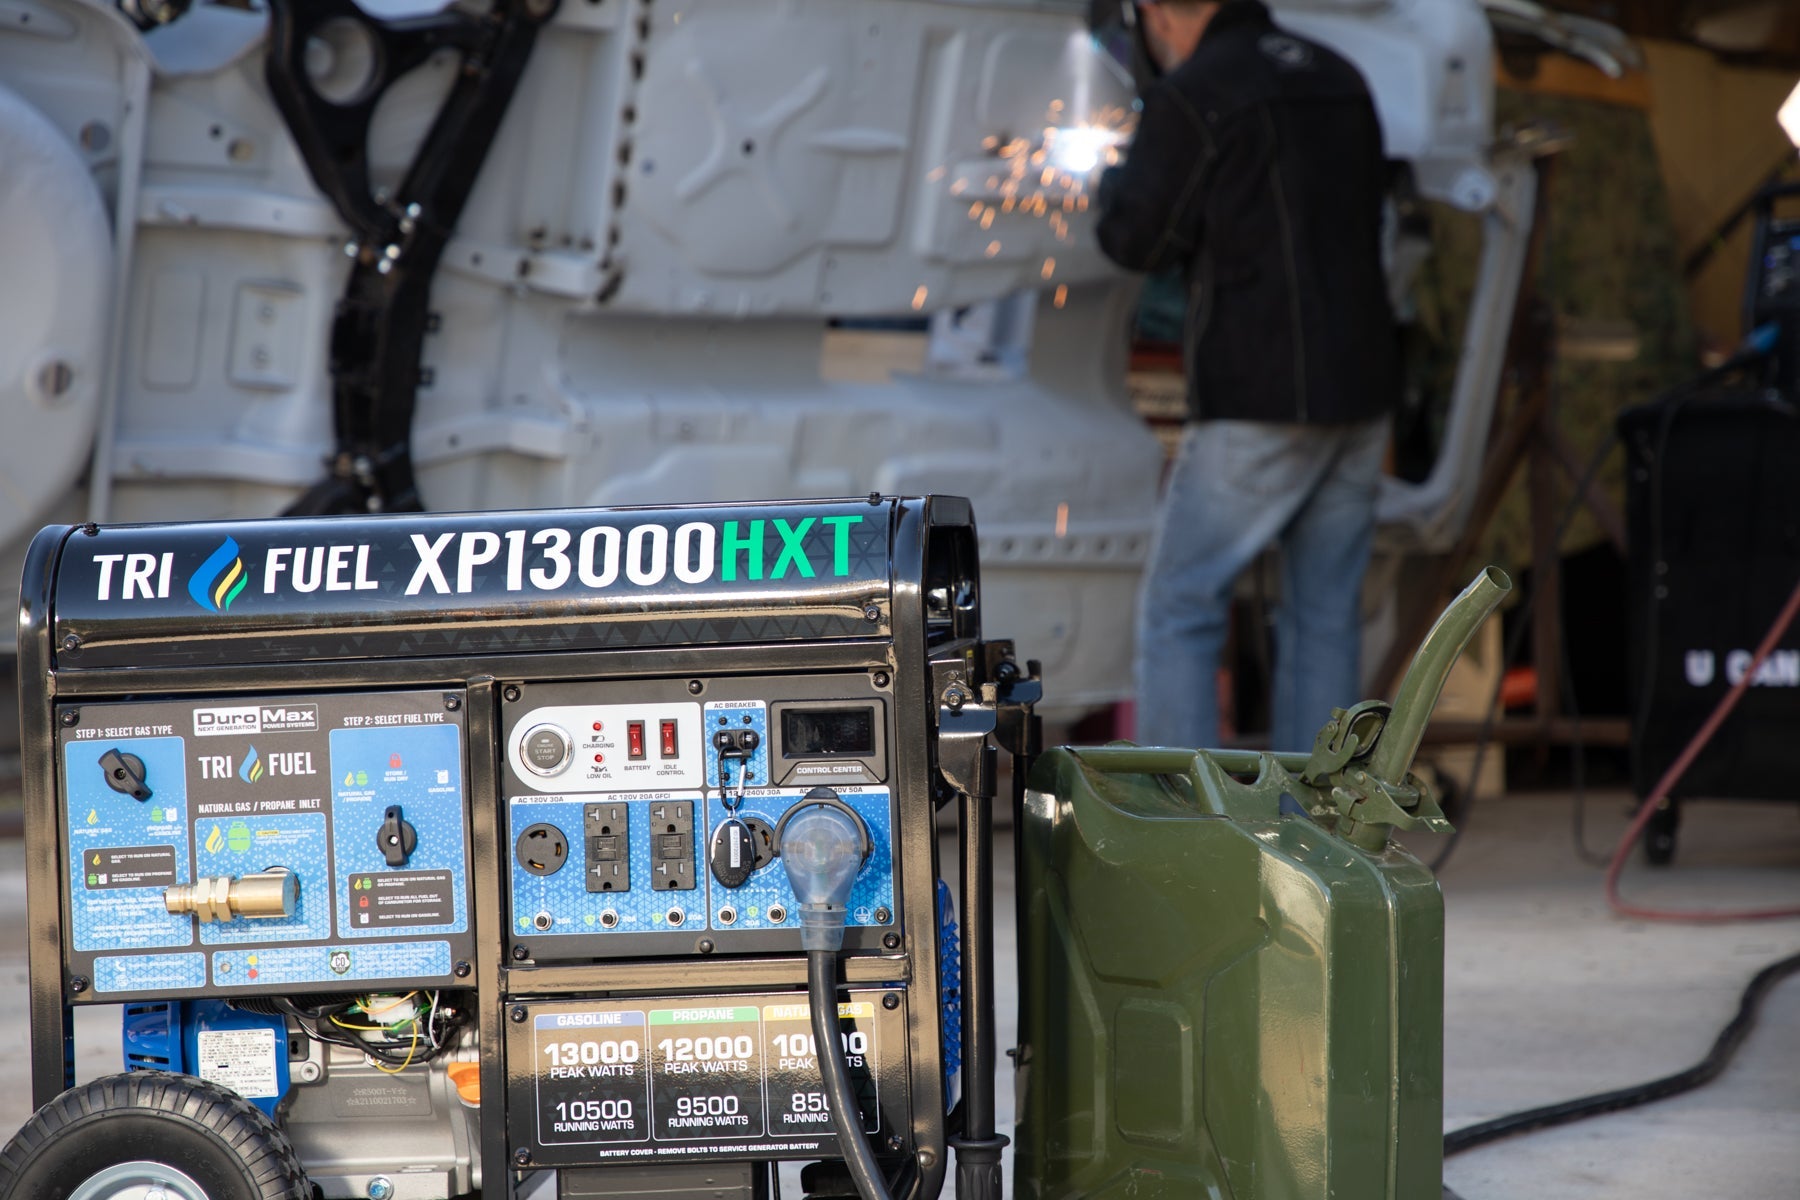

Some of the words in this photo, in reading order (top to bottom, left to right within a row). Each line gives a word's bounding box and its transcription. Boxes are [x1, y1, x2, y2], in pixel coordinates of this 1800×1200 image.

[93, 552, 173, 600] TRI
[264, 545, 378, 594] FUEL
[405, 515, 863, 595] XP13000HXT
[1685, 649, 1716, 687] U
[343, 717, 363, 726] STEP
[365, 716, 373, 725] 2:
[374, 715, 402, 725] SELECT
[403, 714, 422, 724] FUEL
[423, 713, 445, 723] TYPE
[75, 728, 97, 739] STEP
[105, 727, 134, 737] SELECT
[134, 726, 151, 736] GAS
[151, 725, 173, 736] TYPE
[198, 755, 233, 779] TRI
[268, 752, 317, 777] FUEL
[198, 803, 233, 814] NATURAL
[235, 802, 251, 812] GAS
[260, 800, 296, 811] PROPANE
[299, 799, 321, 809] INLET
[335, 957, 345, 967] CO
[673, 1008, 734, 1022] PROPANE
[838, 1004, 863, 1015] GAS
[557, 1013, 622, 1026] GASOLINE
[543, 1040, 639, 1066] 13000
[657, 1035, 753, 1062] 12000
[664, 1062, 699, 1074] PEAK
[702, 1060, 748, 1073] WATTS
[779, 1057, 814, 1070] PEAK
[550, 1066, 585, 1079] PEAK
[588, 1064, 634, 1077] WATTS
[556, 1099, 632, 1121] 10500
[676, 1095, 739, 1117] 9500
[668, 1117, 714, 1128] RUNNING
[715, 1115, 749, 1126] WATTS
[783, 1112, 829, 1124] RUNNING
[554, 1121, 600, 1133] RUNNING
[600, 1119, 635, 1131] WATTS
[600, 1149, 630, 1157] BATTERY
[630, 1148, 654, 1156] COVER
[657, 1147, 686, 1155] REMOVE
[687, 1146, 709, 1154] BOLTS
[719, 1145, 748, 1153] SERVICE
[789, 1142, 819, 1150] BATTERY
